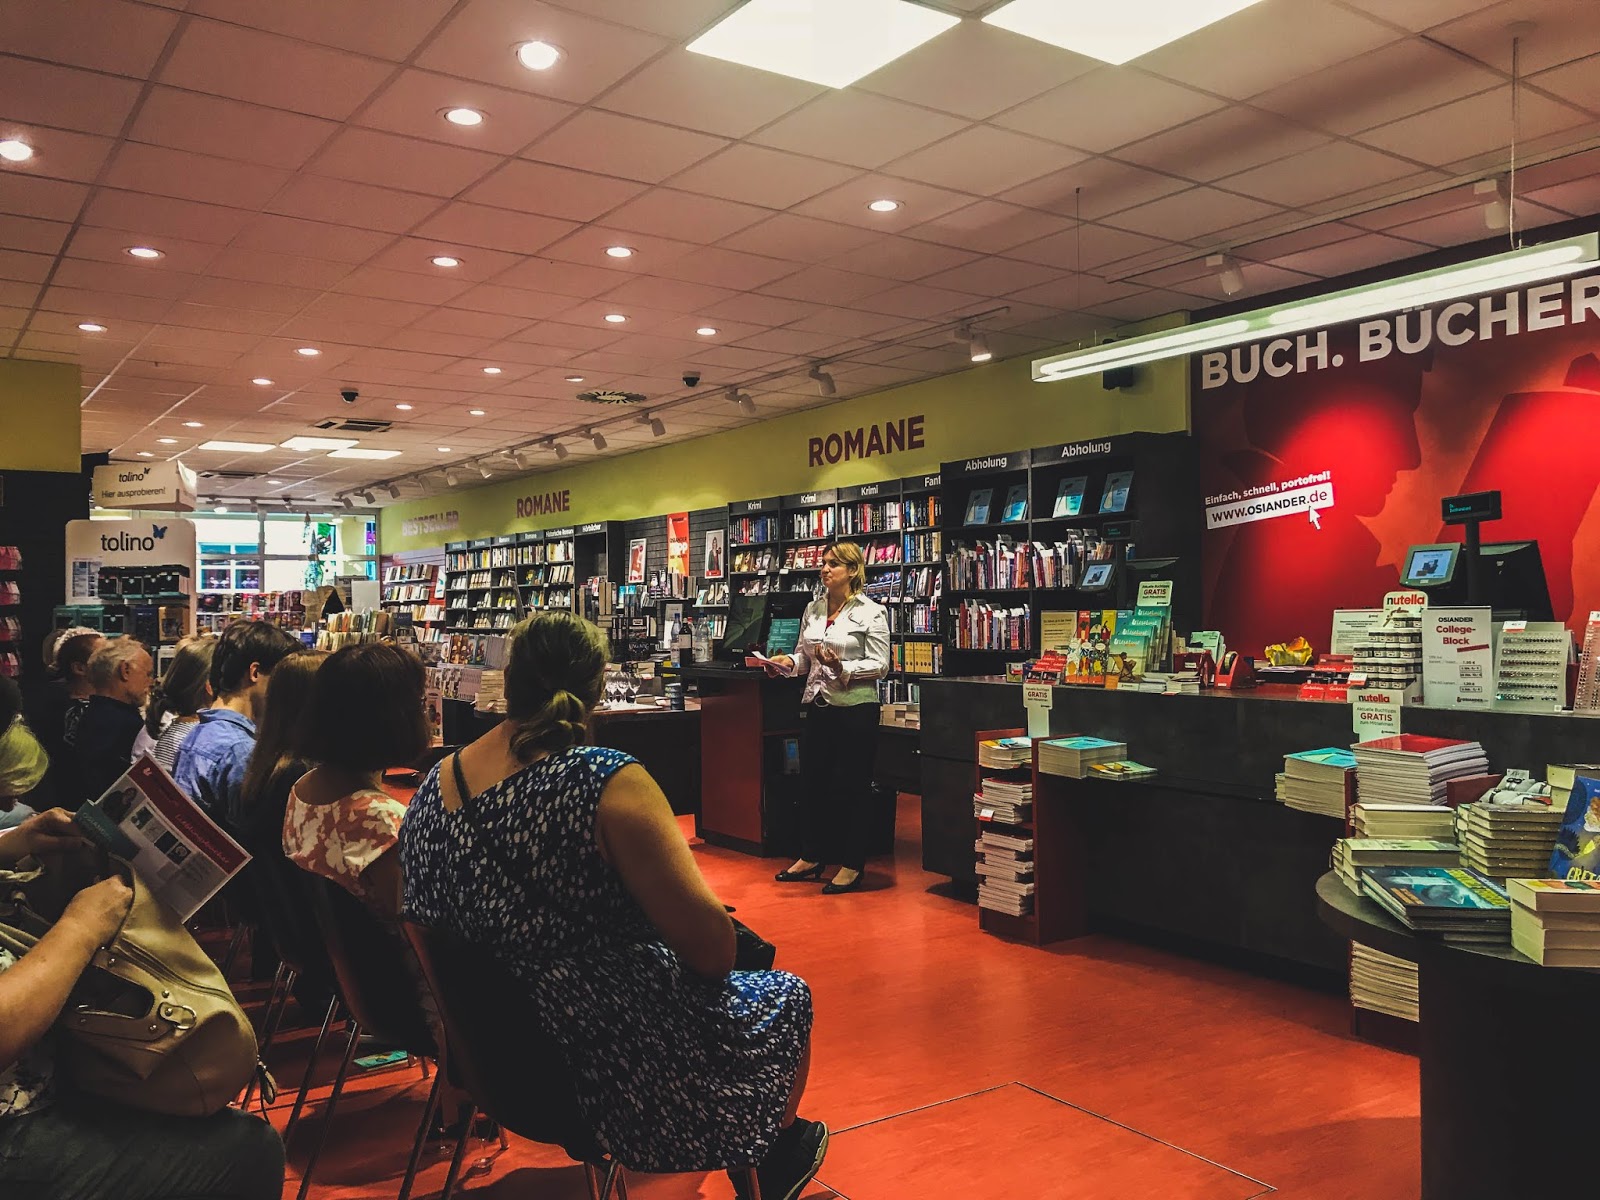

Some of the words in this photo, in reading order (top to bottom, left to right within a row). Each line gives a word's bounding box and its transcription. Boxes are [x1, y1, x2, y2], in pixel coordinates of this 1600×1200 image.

[1202, 330, 1344, 390] BUCH.
[808, 414, 925, 468] ROMANE
[1061, 442, 1112, 458] Abholung
[965, 456, 1008, 472] Abholung
[118, 471, 144, 483] tolino
[101, 490, 116, 499] Hier
[116, 486, 167, 499] ausprobieren!
[861, 484, 879, 496] Krimi
[1204, 491, 1242, 506] Einfach,
[1242, 482, 1280, 498] schnell,
[1280, 470, 1331, 491] portofrei!
[516, 489, 570, 519] ROMANE
[800, 492, 817, 504] Krimi
[747, 500, 762, 511] Krimi
[402, 510, 459, 537] BESTSELLER
[101, 531, 155, 551] tolino
[1387, 594, 1425, 605] nutella
[1436, 625, 1476, 635] College-
[1442, 637, 1470, 645] Block
[1358, 694, 1390, 703] nutella
[1360, 712, 1393, 722] GRATIS
